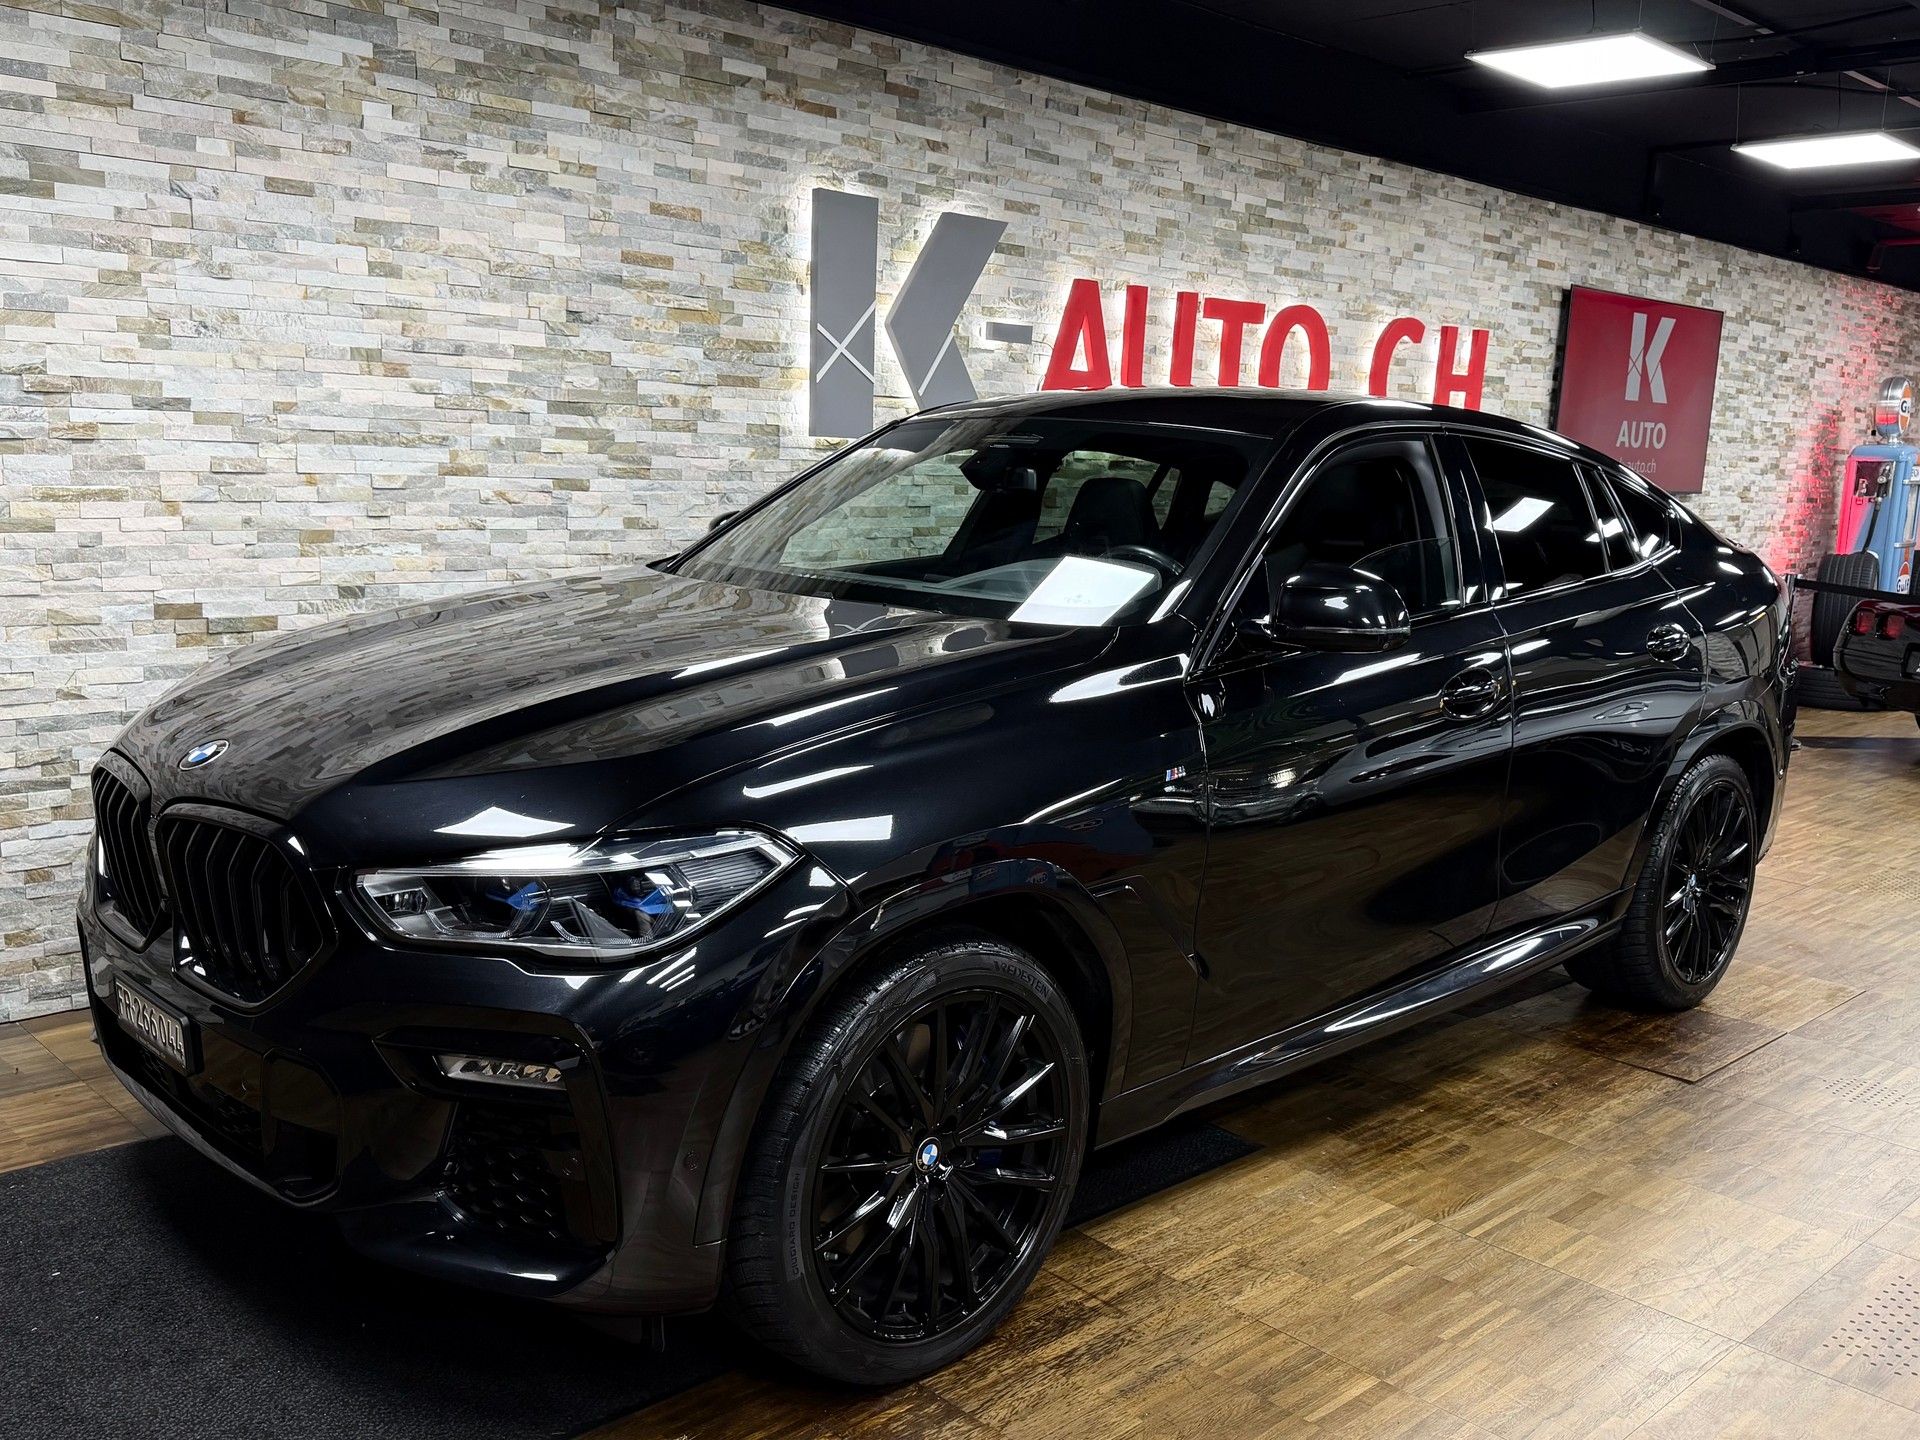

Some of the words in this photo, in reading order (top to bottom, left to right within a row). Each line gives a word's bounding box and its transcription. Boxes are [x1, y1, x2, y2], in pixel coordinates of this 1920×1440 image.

[1625, 312, 1677, 404] K
[1615, 420, 1667, 449] AUTO
[1618, 457, 1657, 474] auto.ch
[993, 960, 1049, 998] VREDESTEIN
